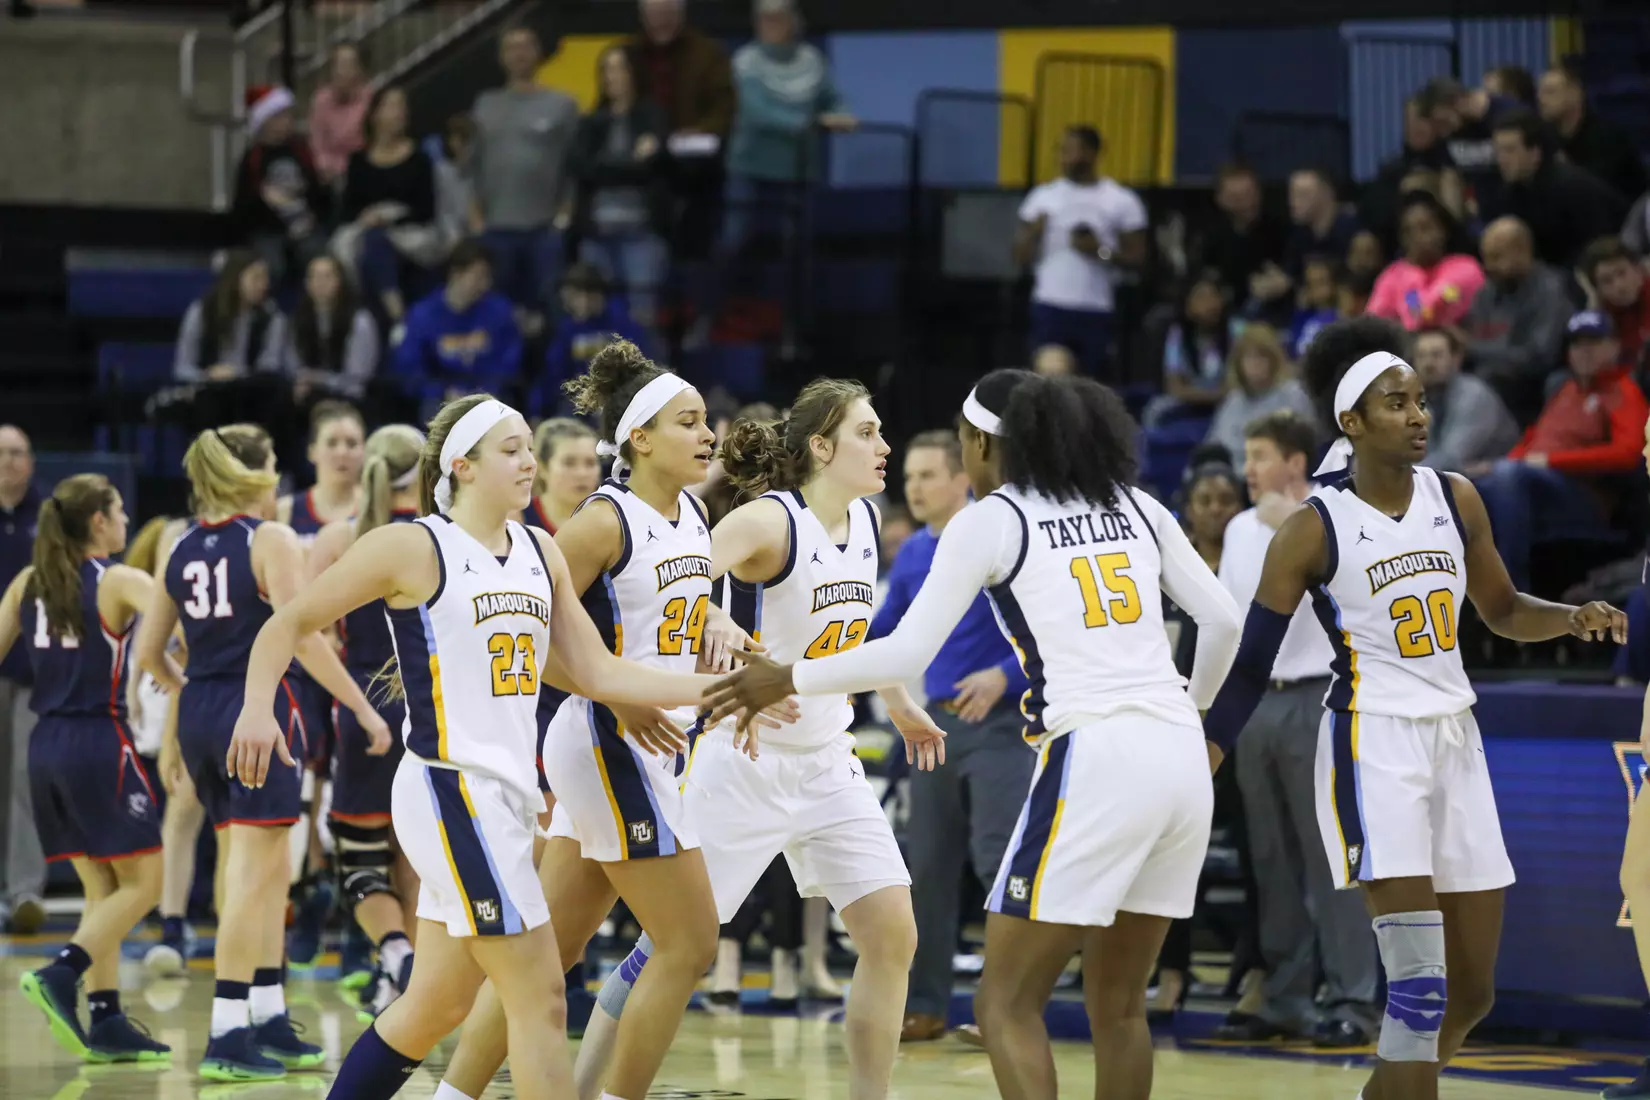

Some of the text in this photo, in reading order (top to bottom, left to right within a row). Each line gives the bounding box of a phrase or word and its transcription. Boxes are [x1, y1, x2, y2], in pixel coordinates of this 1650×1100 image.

[1038, 512, 1138, 549] TAYLOR
[182, 557, 233, 620] 31
[656, 555, 712, 593] MARQUETT
[1069, 552, 1142, 629] 15
[1366, 551, 1457, 596] MARQUETTE
[472, 592, 549, 627] MARQUETTE
[810, 581, 873, 613] MARQUETTE
[33, 597, 80, 649] 1
[657, 594, 710, 655] 24
[803, 618, 868, 660] 42
[1389, 588, 1456, 658] 20
[487, 632, 538, 697] 23
[630, 821, 653, 842] MU
[474, 899, 497, 921] MU
